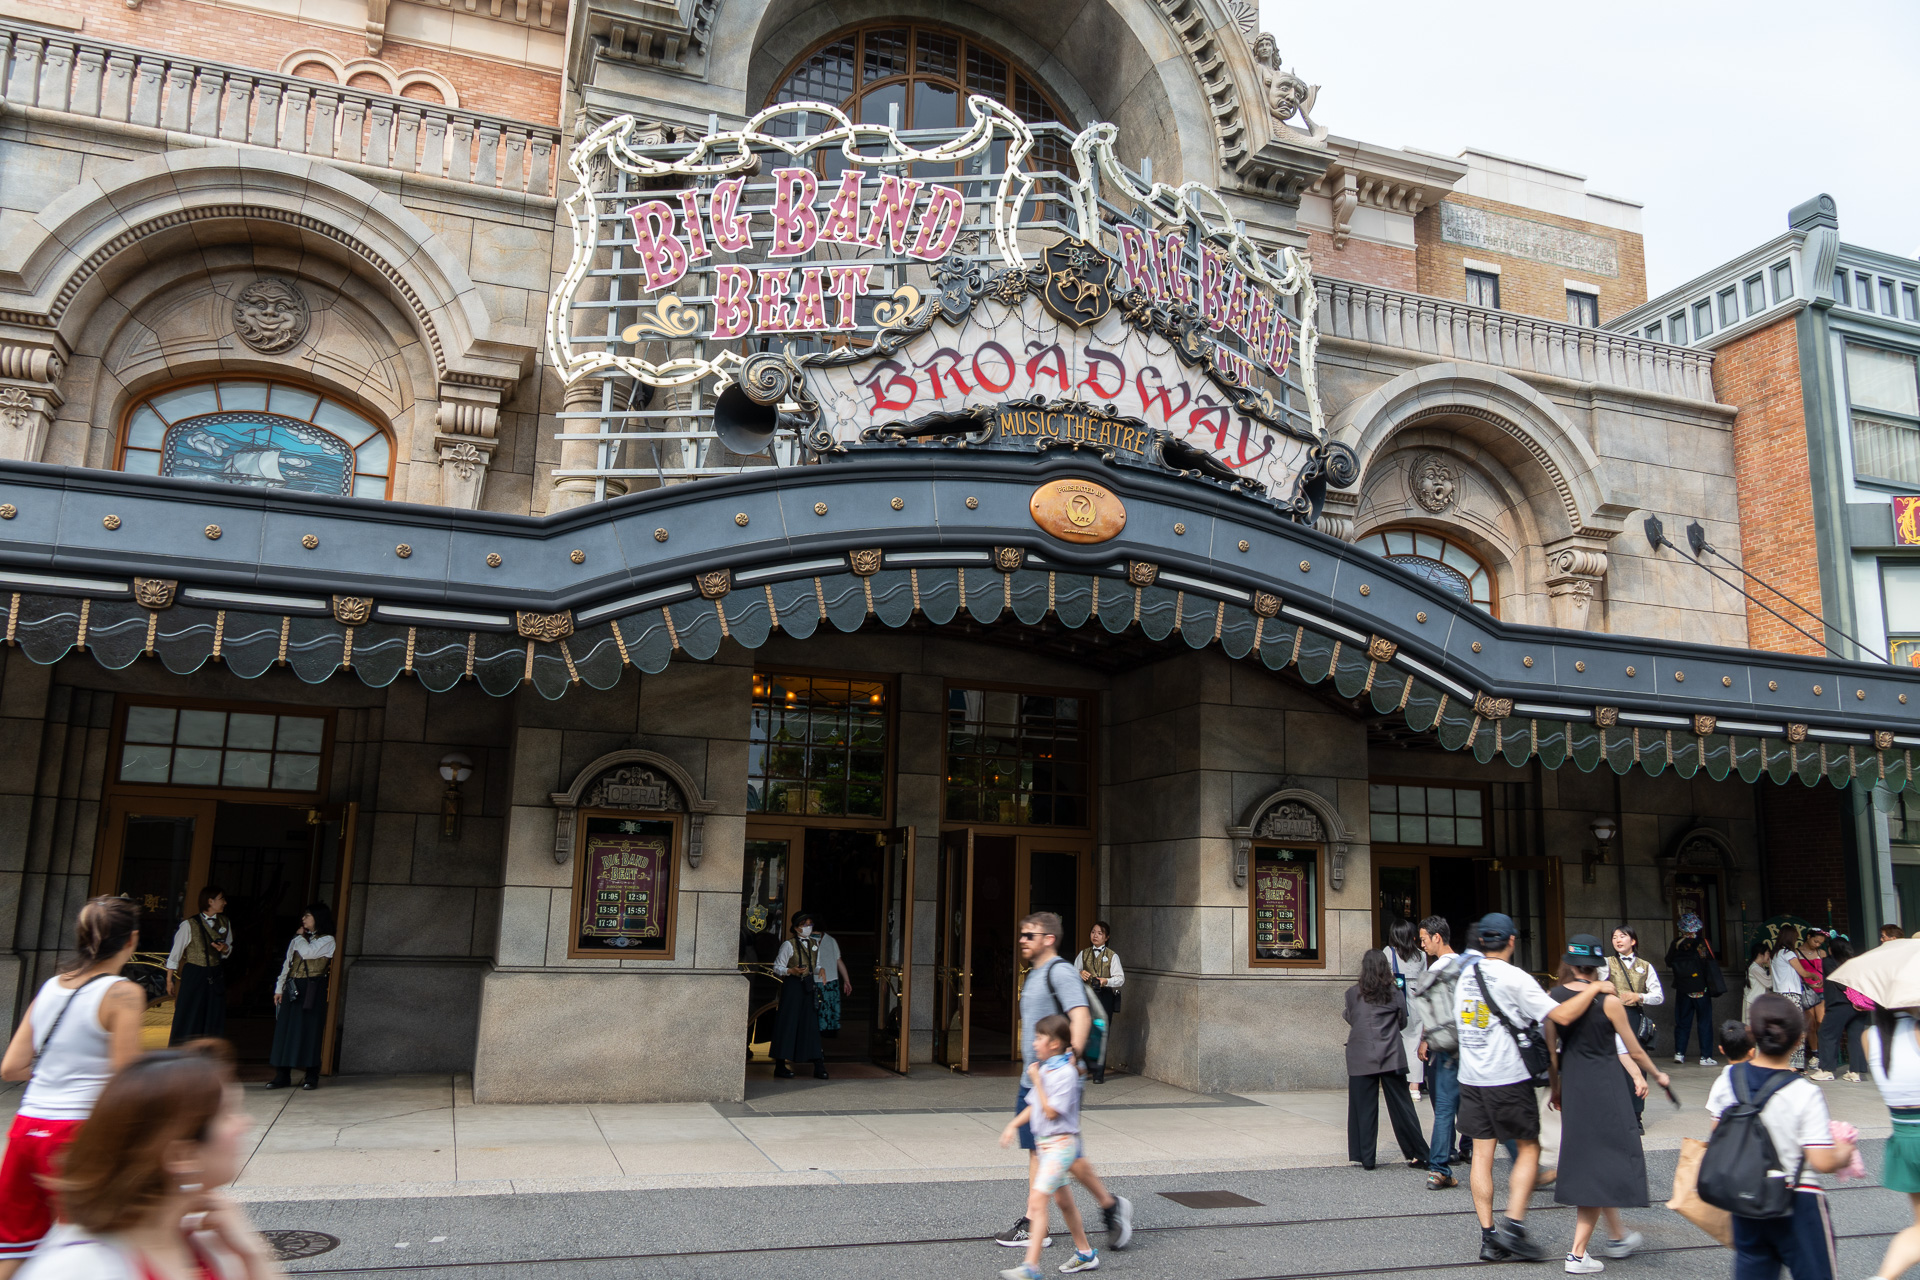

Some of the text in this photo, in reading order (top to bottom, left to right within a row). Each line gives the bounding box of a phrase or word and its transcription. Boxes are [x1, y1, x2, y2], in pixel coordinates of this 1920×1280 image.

[625, 167, 966, 293] BIG BAND
[709, 264, 874, 340] BEAT
[1115, 224, 1192, 306] BIG
[1198, 242, 1291, 377] BAND
[853, 341, 1275, 469] BROADWAY
[1000, 411, 1149, 455] MUSIC THEATRE
[1057, 485, 1105, 498] PRESENTED BY
[612, 787, 657, 803] OPERA
[1275, 821, 1310, 835] DRAMA
[601, 853, 650, 870] BIG BAND
[611, 867, 638, 880] BEAT
[1272, 877, 1292, 890] BAND
[600, 893, 619, 901] 11:05
[1265, 889, 1285, 900] BEAT
[599, 906, 646, 915] 13:55 15:55
[598, 919, 617, 927] 17:20
